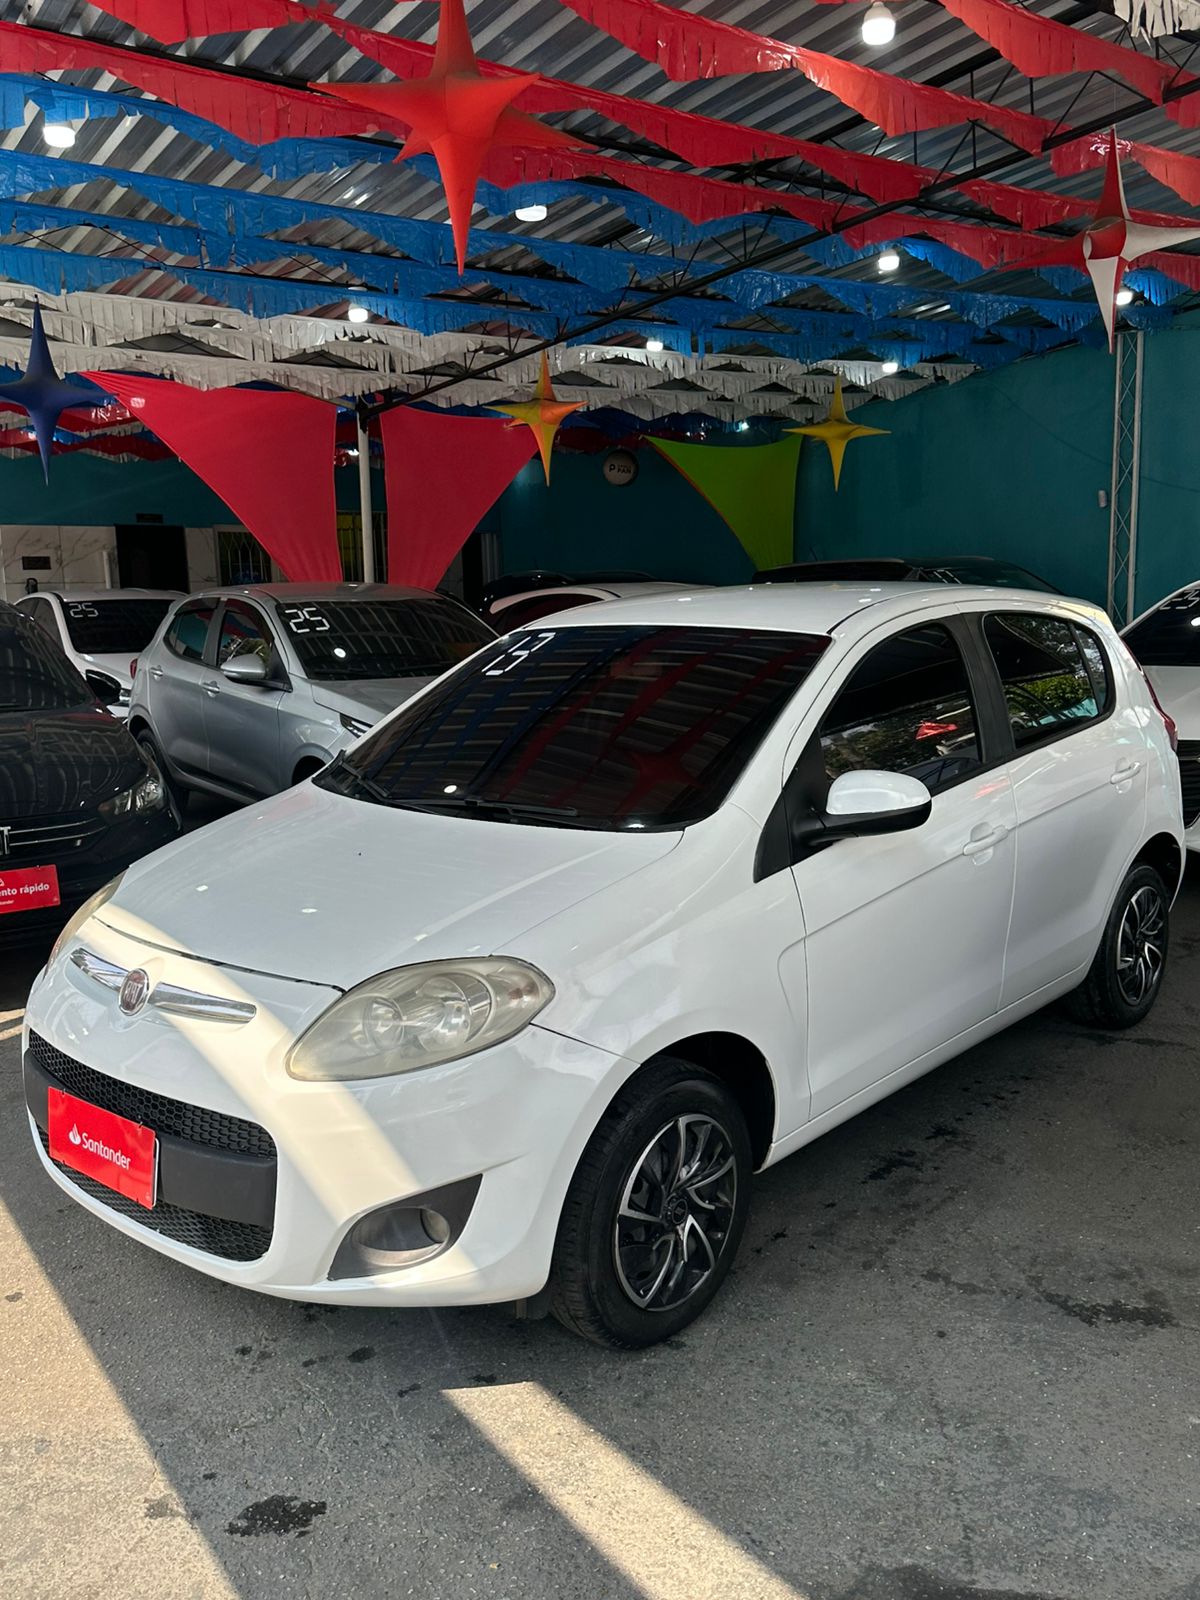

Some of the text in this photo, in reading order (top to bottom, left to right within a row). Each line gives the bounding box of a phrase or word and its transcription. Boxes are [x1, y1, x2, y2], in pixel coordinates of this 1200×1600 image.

[68, 602, 99, 618] 25
[285, 607, 330, 633] 25
[19, 882, 50, 896] rápido
[122, 980, 143, 1005] FIAT
[81, 1132, 131, 1170] Santander
